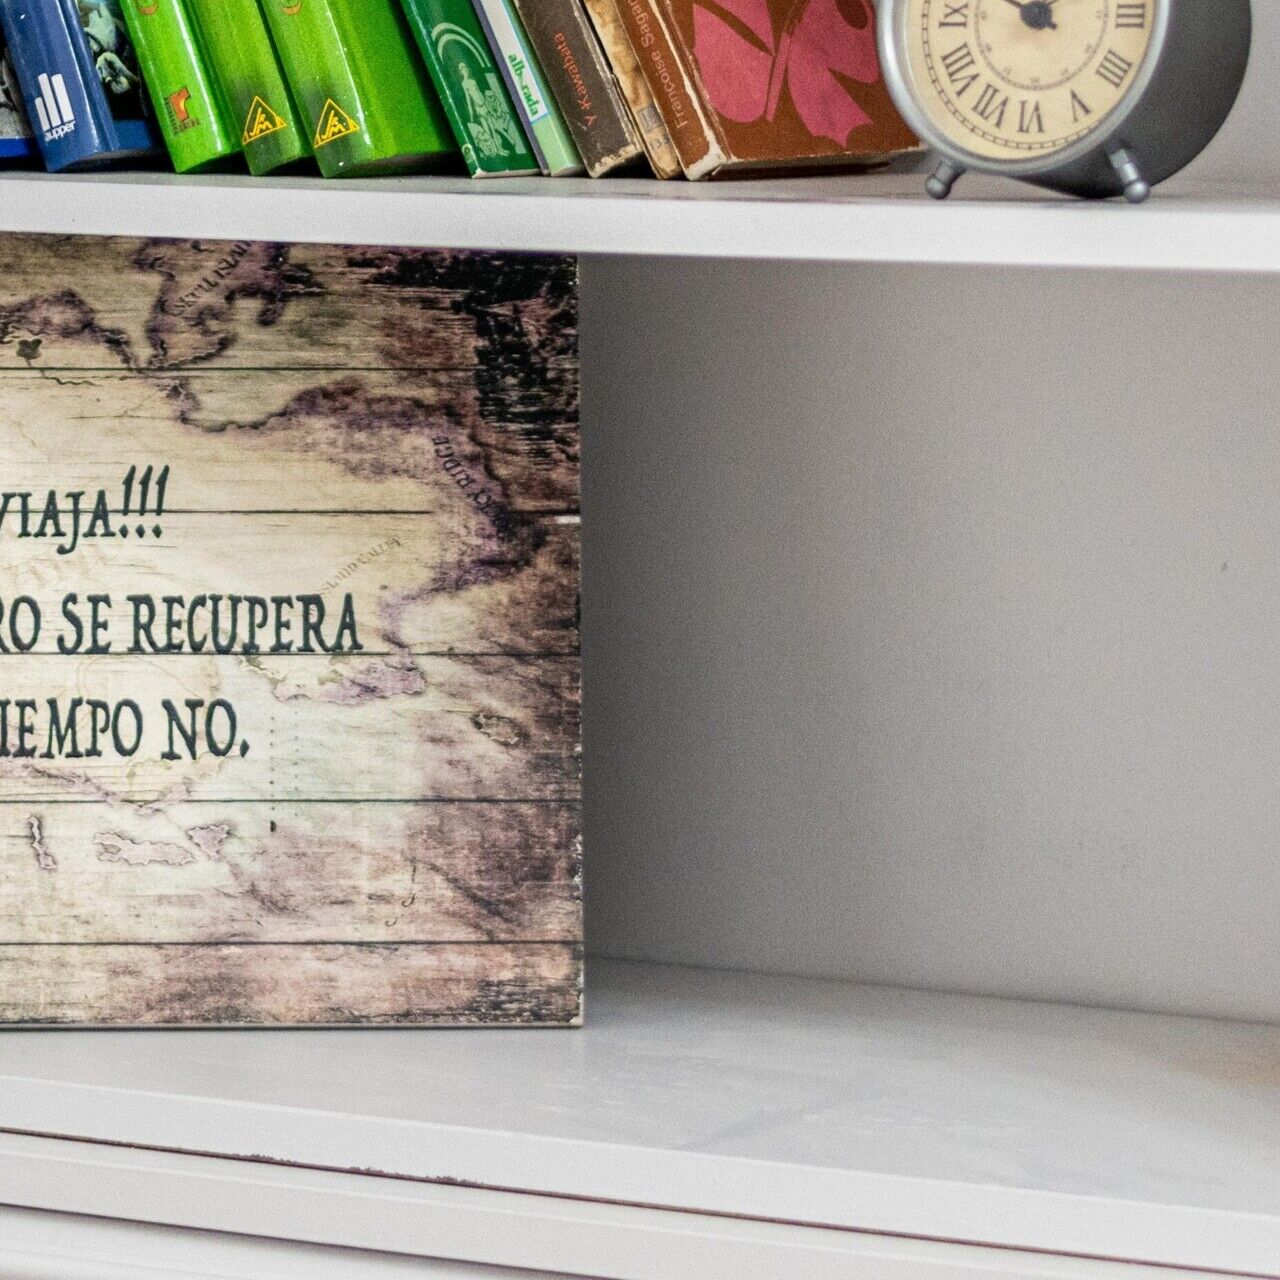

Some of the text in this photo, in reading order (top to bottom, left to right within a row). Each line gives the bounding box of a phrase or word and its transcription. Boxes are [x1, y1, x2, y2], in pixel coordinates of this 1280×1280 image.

[938, 2, 969, 28] IX
[1115, 3, 1146, 29] III
[554, 32, 591, 109] Kawabata
[651, 50, 691, 129] Françoise
[941, 42, 980, 97] VIII
[1095, 49, 1133, 89] IIII
[972, 83, 1009, 128] VII
[1017, 100, 1045, 133] VI
[1070, 89, 1091, 123] V
[57, 593, 112, 655] SE
[126, 593, 364, 654] RECUPERA
[161, 698, 250, 760] NO.
